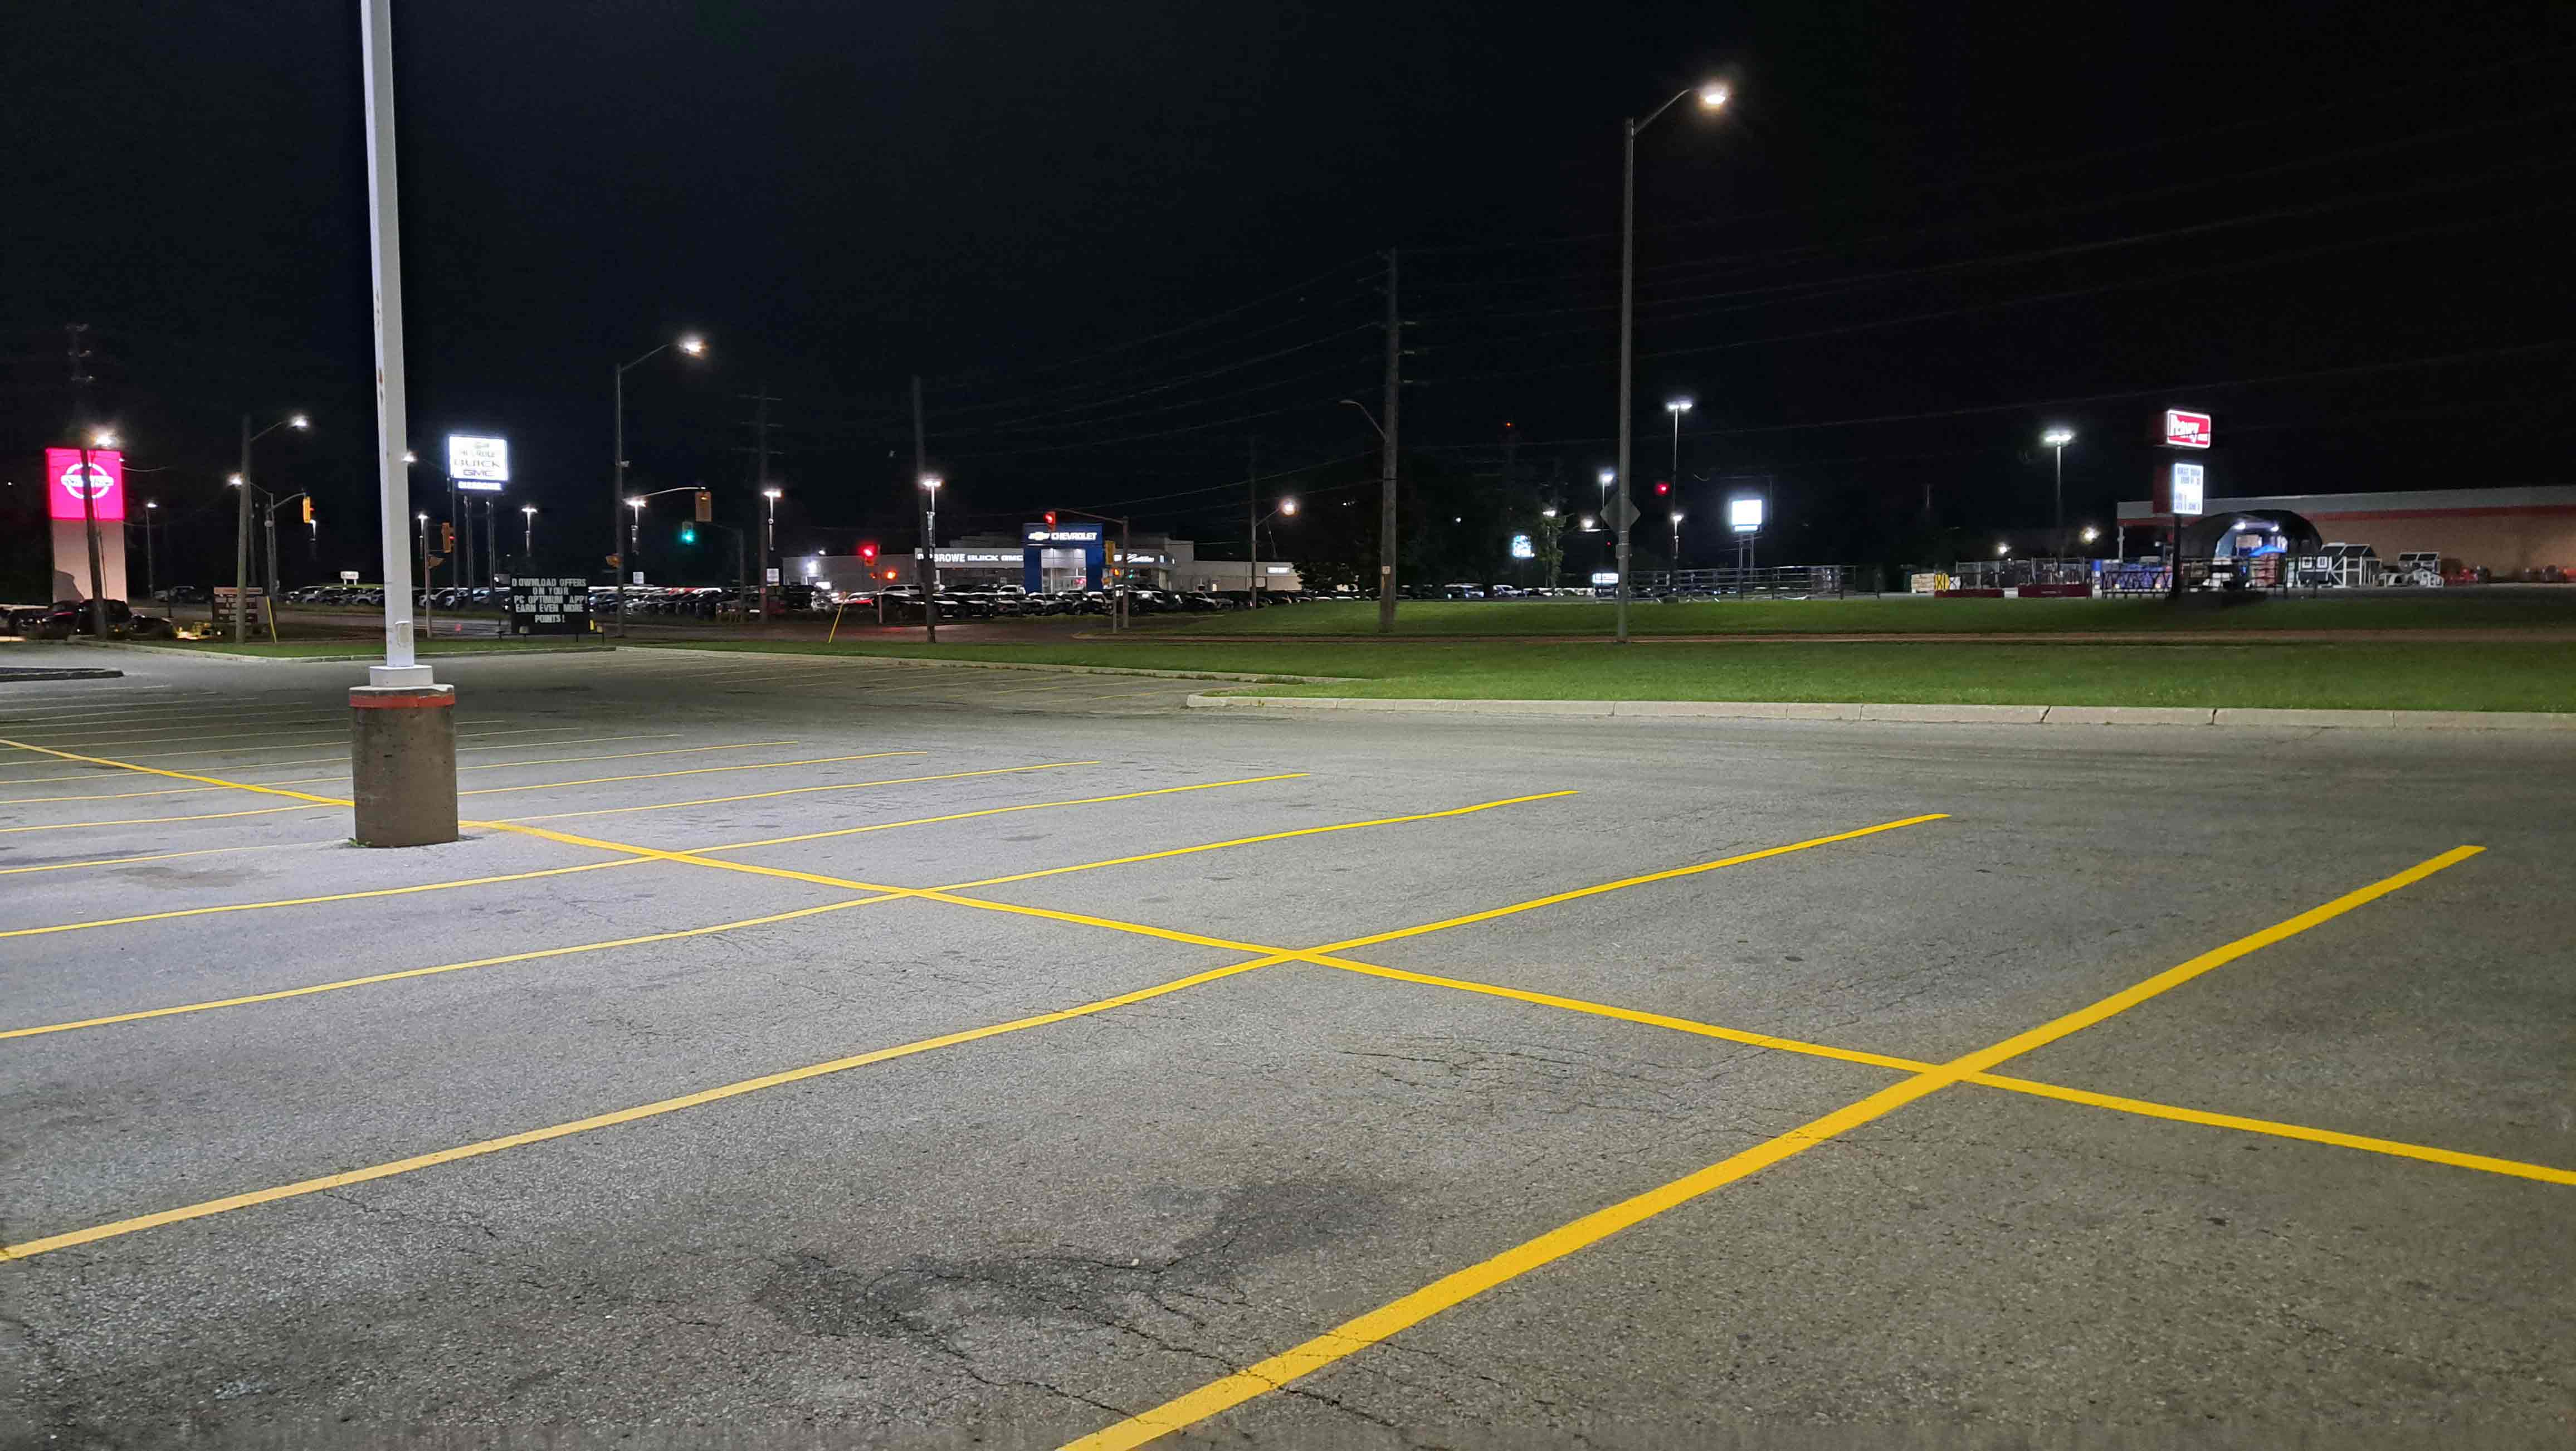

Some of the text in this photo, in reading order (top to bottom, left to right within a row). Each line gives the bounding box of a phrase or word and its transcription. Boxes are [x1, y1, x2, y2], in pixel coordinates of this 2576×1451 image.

[1050, 532, 1097, 541] CHEVROLET
[511, 578, 587, 587] DOWNLOAD OFFERS
[532, 587, 569, 595] ON YOUR
[513, 595, 588, 604] PC OPTIMUM APP!
[515, 604, 584, 612] EARN EVEN MORE
